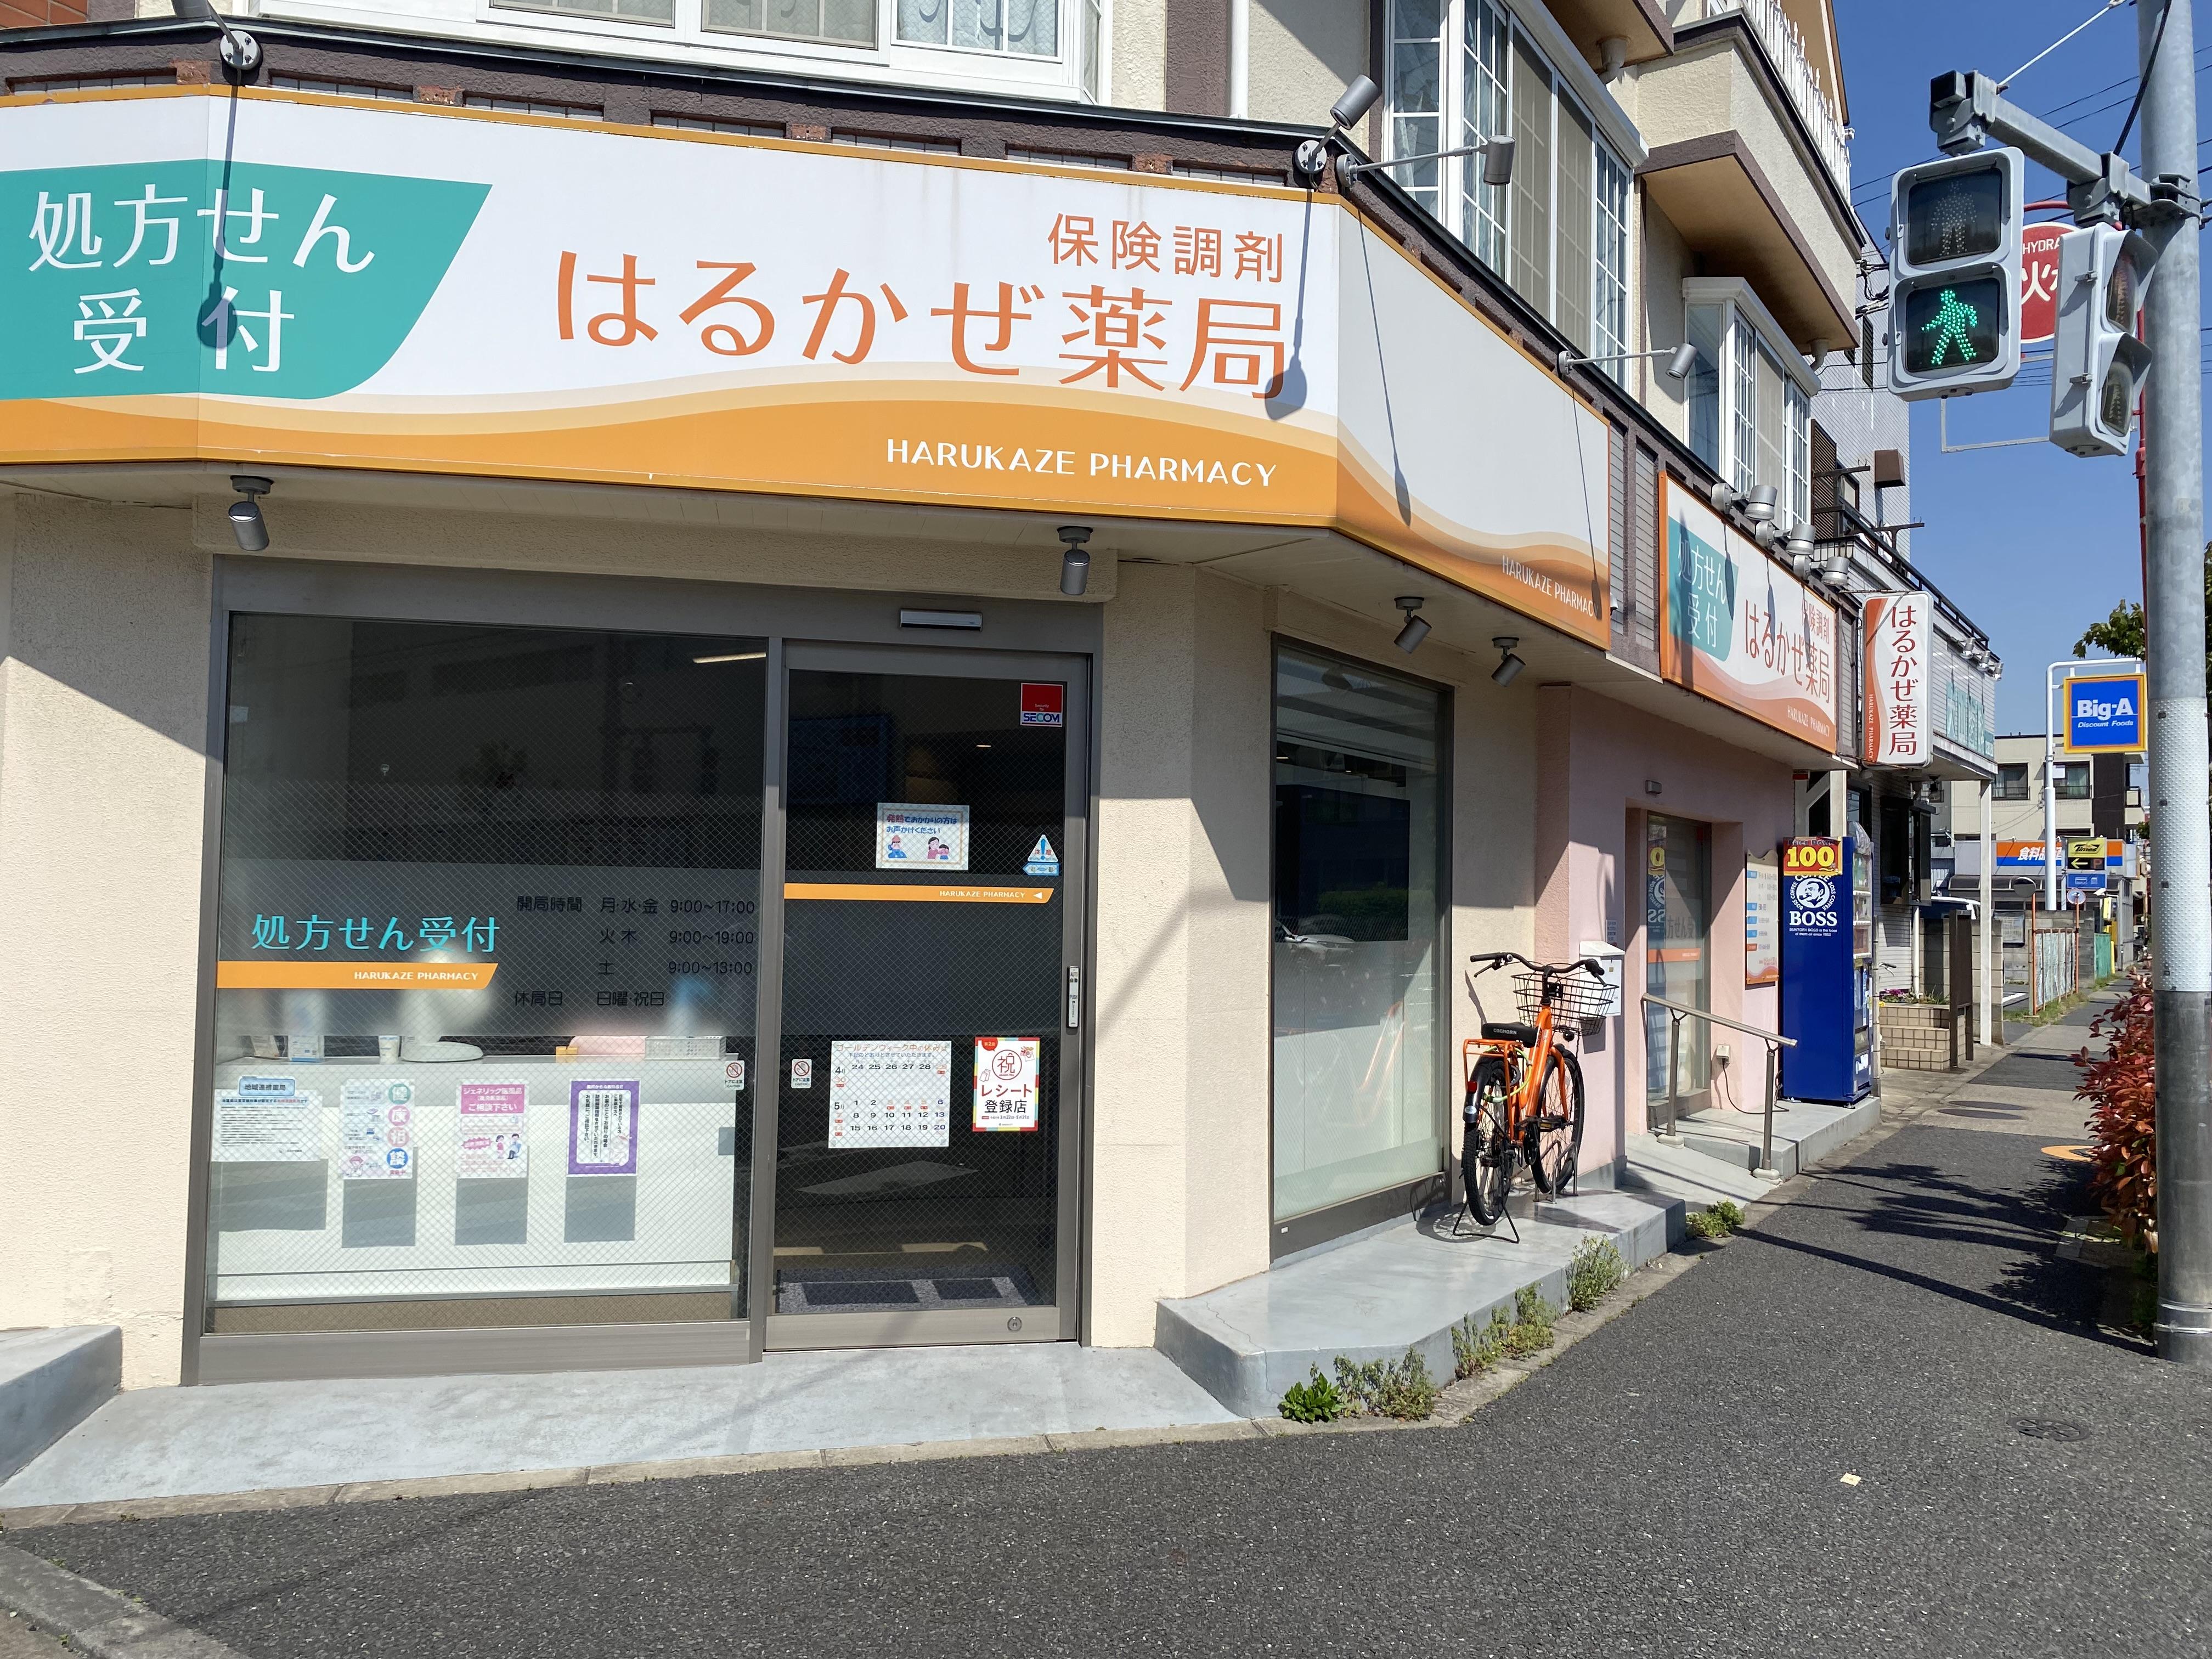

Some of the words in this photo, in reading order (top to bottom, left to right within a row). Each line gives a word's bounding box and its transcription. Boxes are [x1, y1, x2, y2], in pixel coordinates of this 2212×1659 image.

[29, 184, 375, 273] 処方せん
[1048, 213, 1283, 283] 保険調剤
[73, 286, 295, 375] 受付
[557, 250, 1285, 399] はるかぜ薬局
[887, 438, 1076, 475] HARUKAZE
[1090, 452, 1277, 487] PHARMACY
[1678, 534, 1726, 604] 処方せん
[1502, 555, 1553, 596] HARUKAZE
[1555, 582, 1598, 619] PHARMACY
[1688, 592, 1718, 648] 受付
[1745, 599, 1830, 703] はるかぜ薬局
[1889, 605, 1918, 755] はるかぜ薬局
[1023, 713, 1060, 723] SECOM
[1787, 704, 1809, 727] HARUKAZE
[2077, 698, 2134, 720] Big-A
[886, 825, 940, 834] お声かけください
[1787, 846, 1835, 867] 100
[2017, 847, 2062, 861] 食料品
[2093, 859, 2103, 869] P
[1790, 881, 1798, 899] COFFEE
[517, 896, 582, 912] 開局時間
[1789, 911, 1837, 926] BOSS
[251, 913, 500, 953] 処方せん受付
[599, 928, 616, 945] 火
[620, 929, 637, 944] 木
[354, 972, 414, 980] HARUKAZE
[417, 972, 478, 980] PHARMACY
[598, 960, 614, 975] 土
[515, 990, 562, 1006] 休局日
[997, 1053, 1015, 1074] 祝
[981, 1084, 1032, 1097] レシート
[984, 1099, 1028, 1113] 登録店
